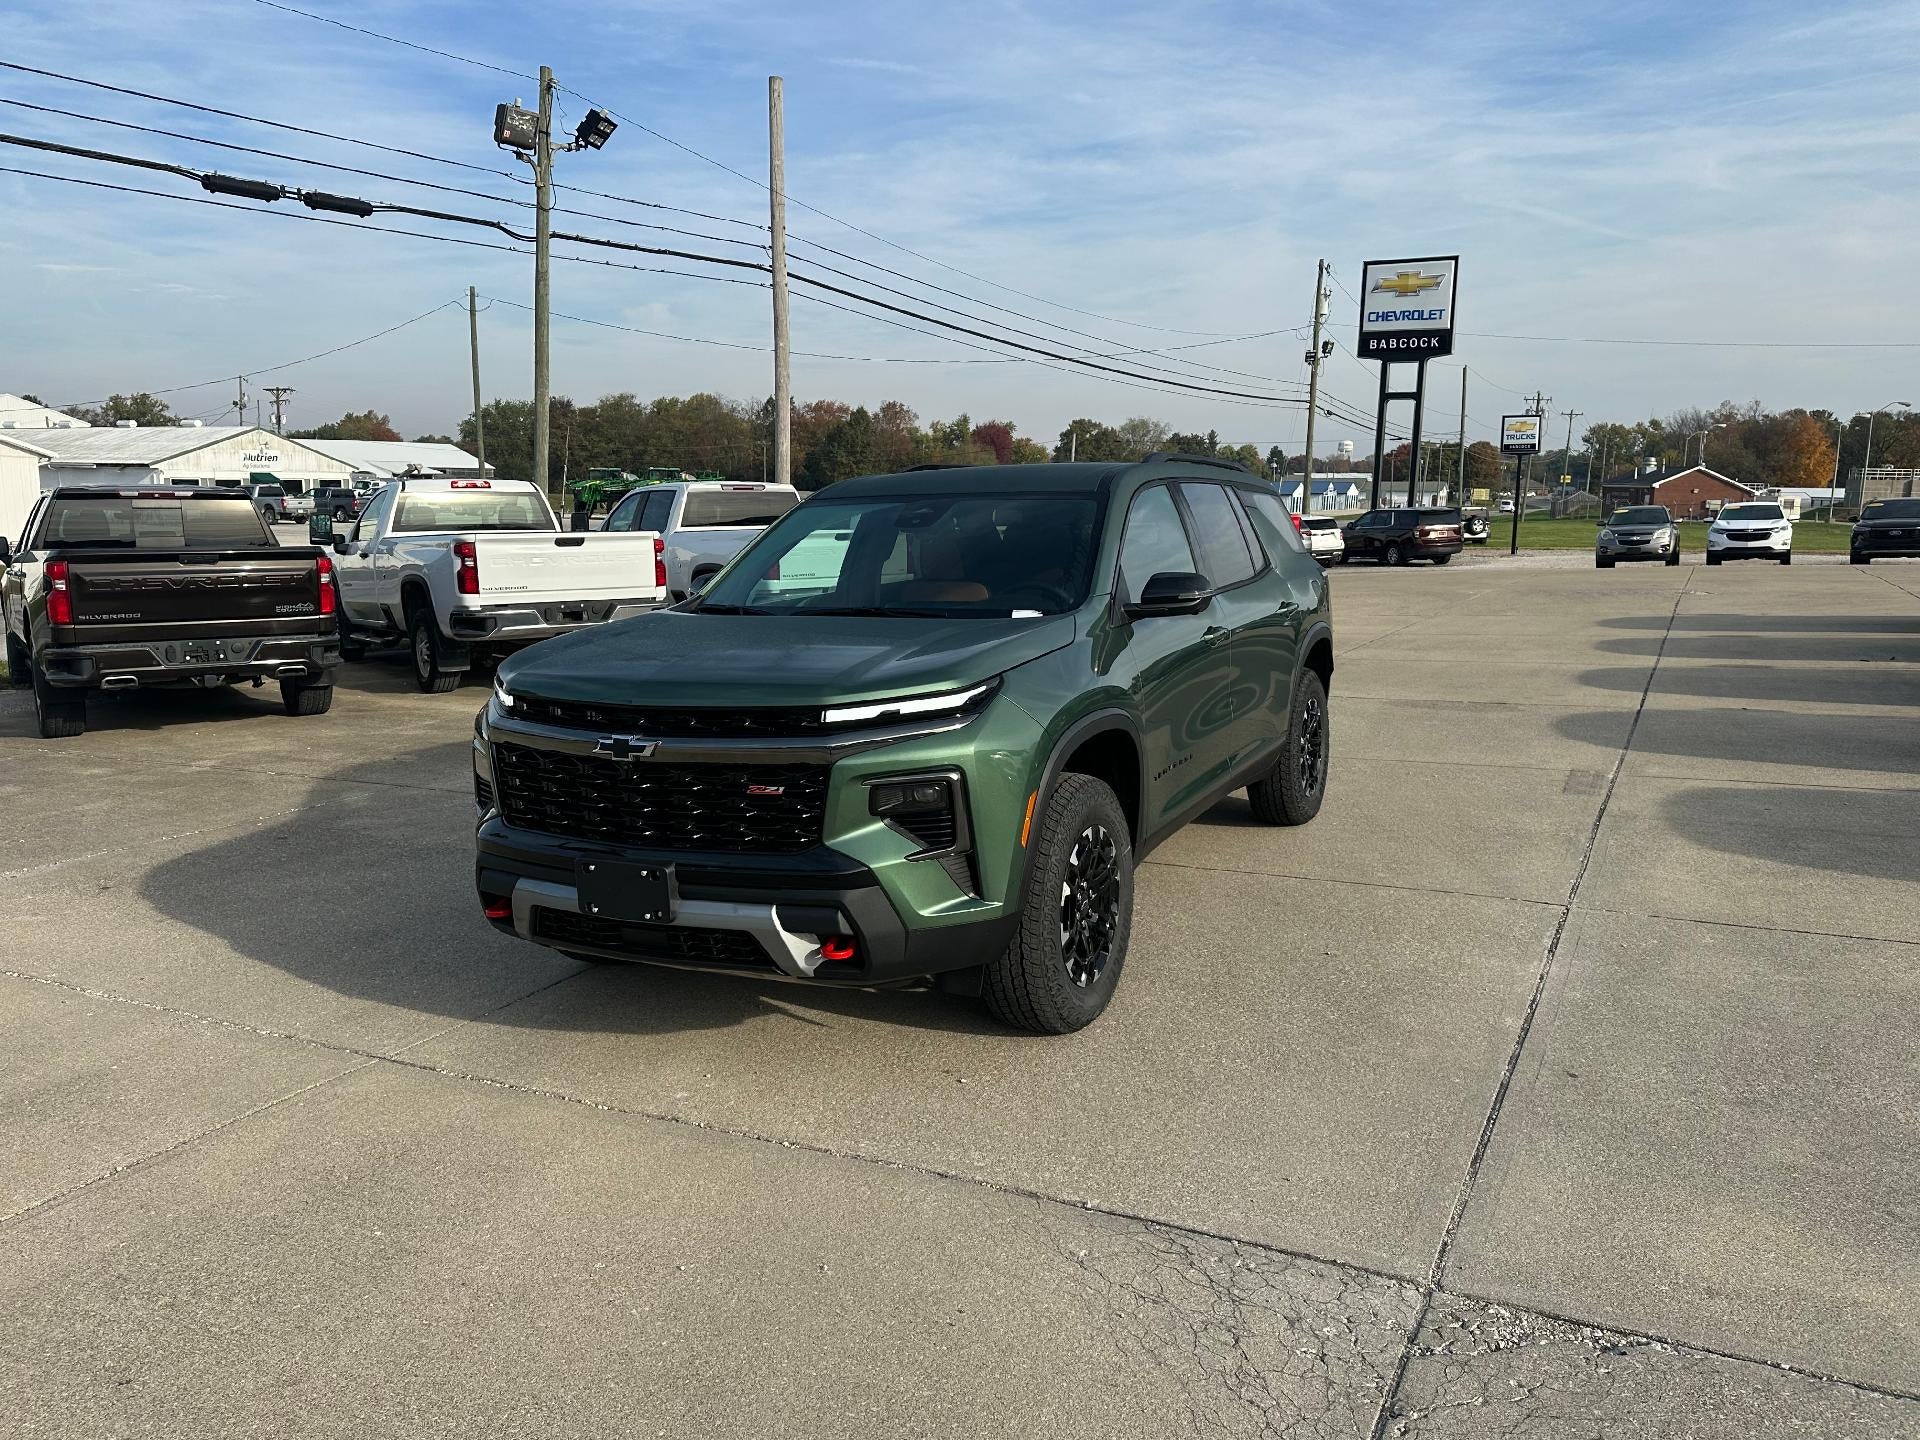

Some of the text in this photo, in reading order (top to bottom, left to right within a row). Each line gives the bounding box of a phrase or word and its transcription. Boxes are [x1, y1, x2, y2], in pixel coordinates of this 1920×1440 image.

[1367, 308, 1446, 323] CHEVROLET
[1369, 337, 1440, 349] BABCOCK
[1505, 433, 1537, 441] TRUCKS
[243, 452, 279, 462] Nutrien
[88, 575, 304, 591] CHEVROLET
[78, 612, 141, 620] SILVERADO
